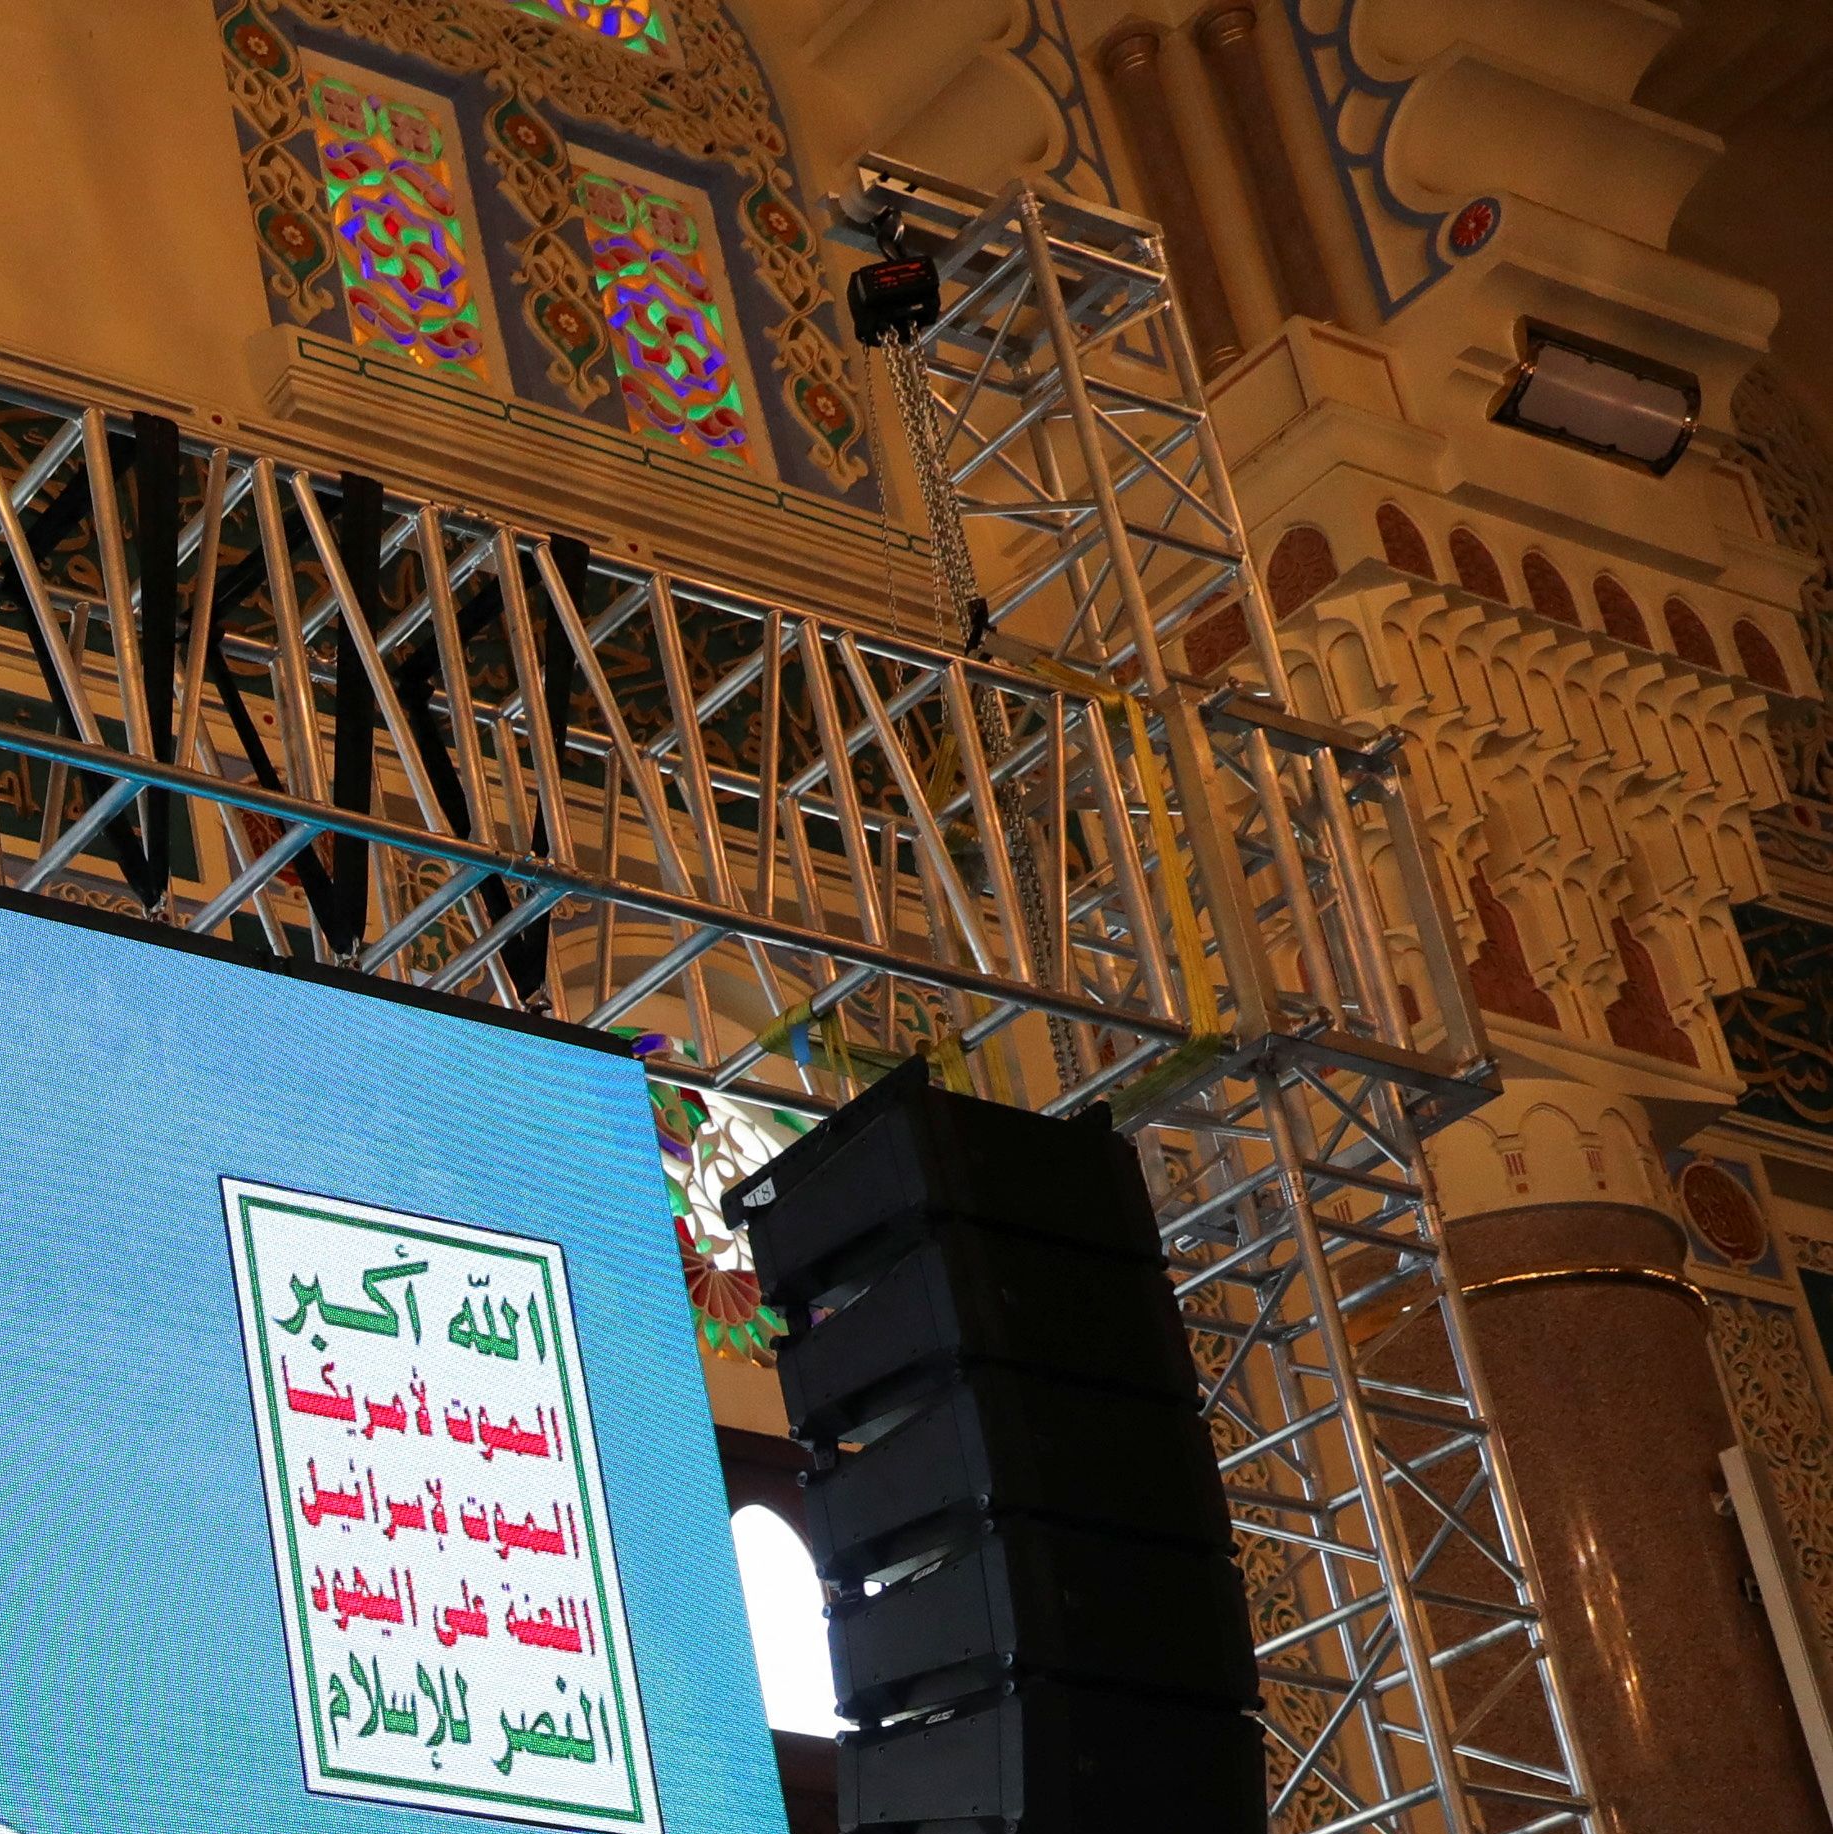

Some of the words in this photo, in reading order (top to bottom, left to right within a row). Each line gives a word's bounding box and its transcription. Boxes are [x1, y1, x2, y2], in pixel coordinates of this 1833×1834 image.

[272, 1243, 430, 1354] أكبر
[448, 1273, 546, 1365] الله
[280, 1354, 434, 1440] لأمريكا
[443, 1395, 564, 1462] الموت
[297, 1456, 449, 1551] لإسرائيل
[459, 1493, 580, 1560] الموت
[310, 1563, 419, 1638] اليهود
[433, 1578, 489, 1647] على
[503, 1580, 596, 1656] اللعنة
[326, 1648, 471, 1770] للإسلام
[491, 1674, 614, 1776] النصر
